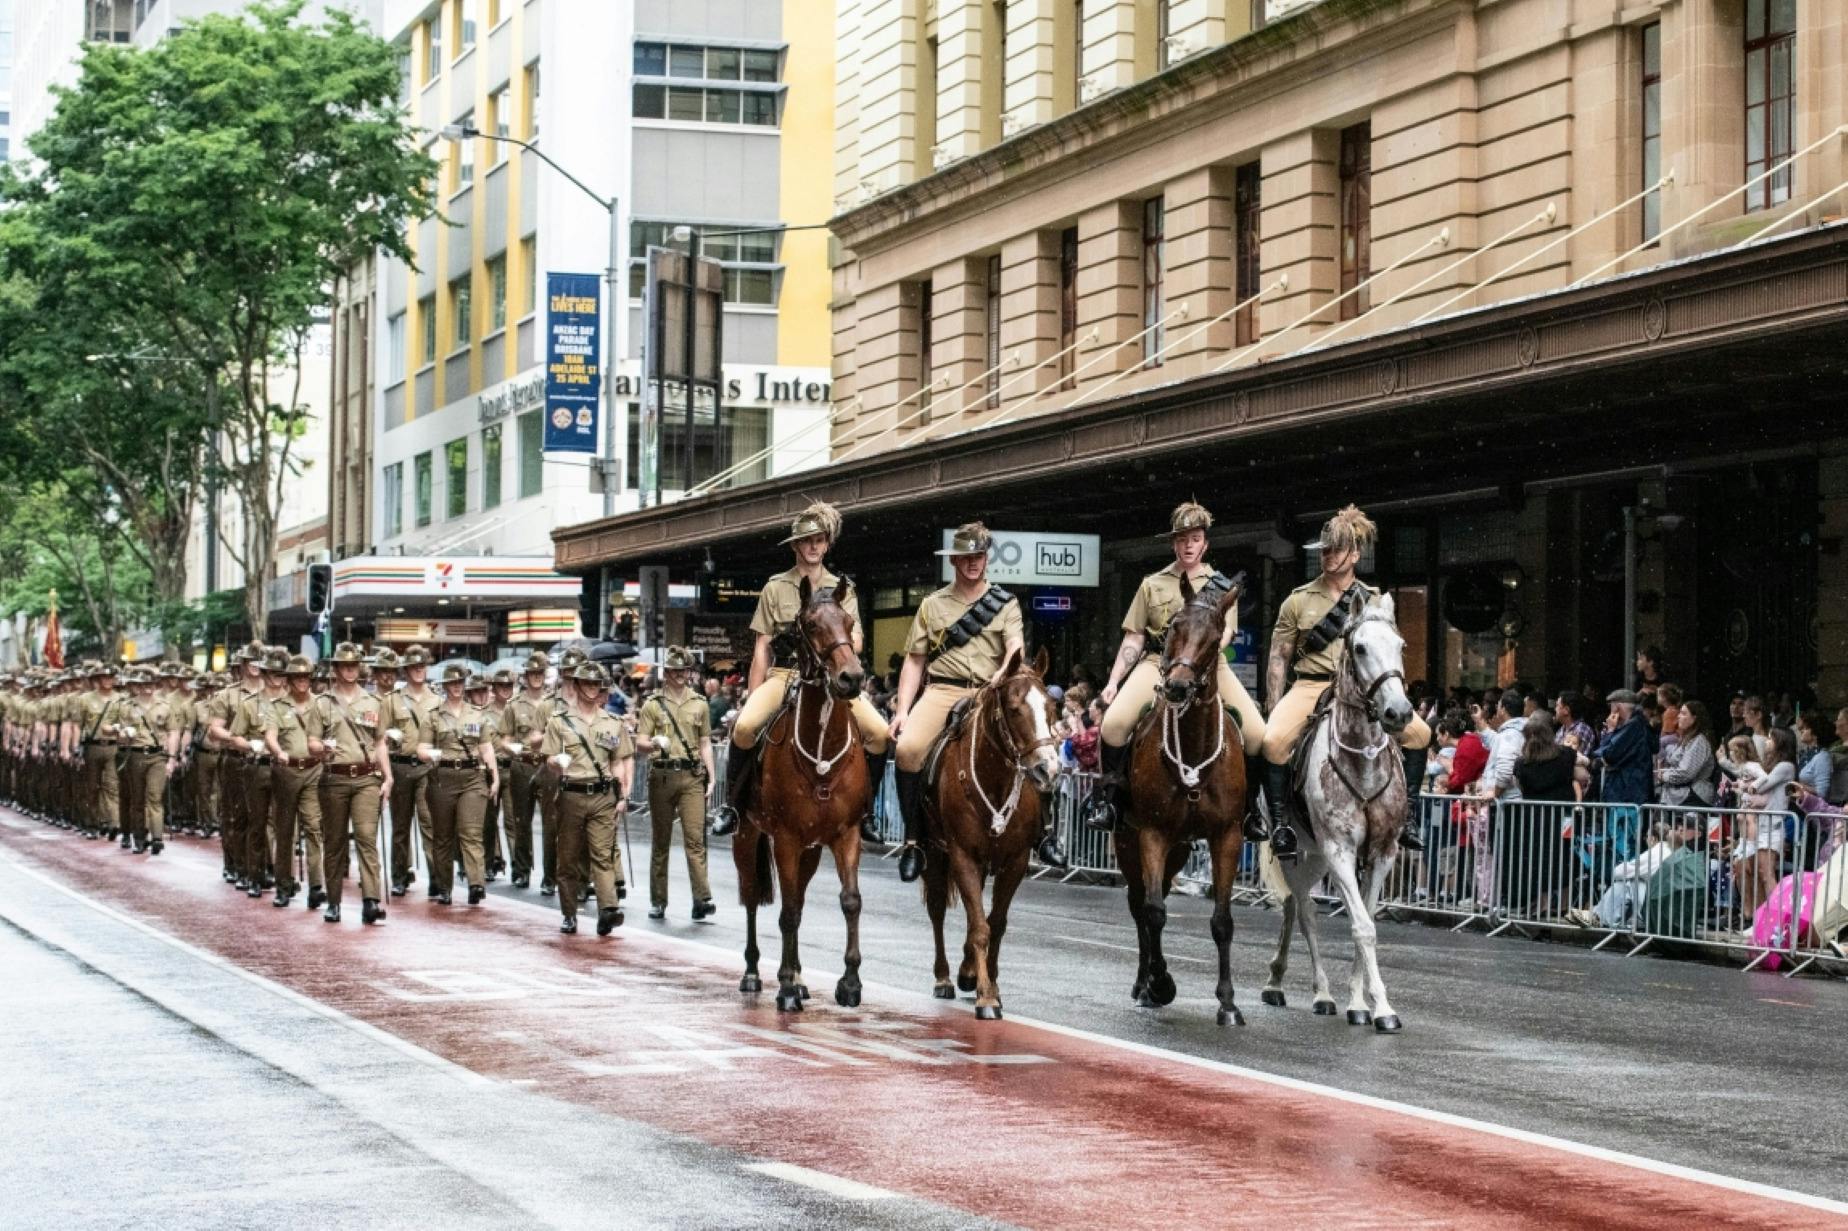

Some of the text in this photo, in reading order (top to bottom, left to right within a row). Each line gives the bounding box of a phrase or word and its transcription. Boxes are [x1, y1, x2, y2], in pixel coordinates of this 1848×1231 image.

[553, 325, 595, 336] ANZAC DAY
[558, 336, 589, 345] PARADE
[555, 344, 592, 355] BRISBANE
[550, 363, 597, 375] ADELAIDE ST
[556, 374, 590, 385] 25 APRIL
[1041, 547, 1075, 566] hub
